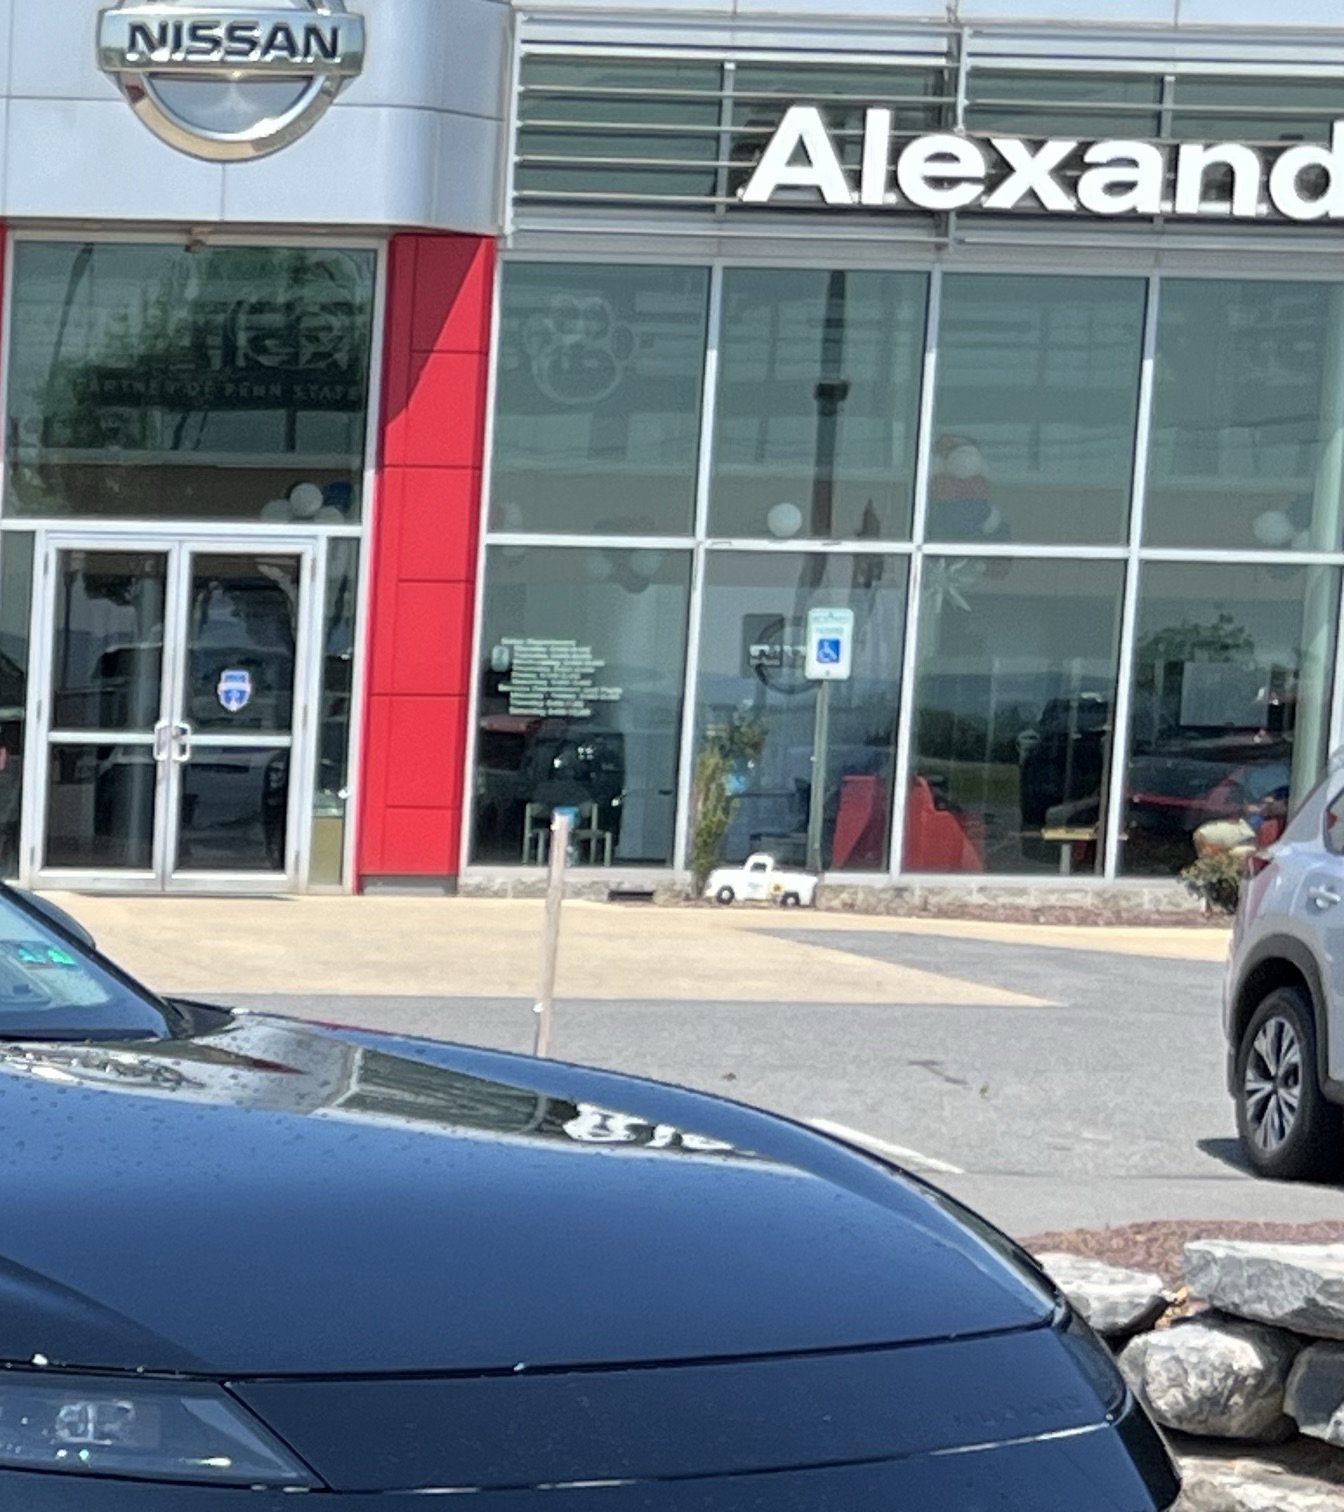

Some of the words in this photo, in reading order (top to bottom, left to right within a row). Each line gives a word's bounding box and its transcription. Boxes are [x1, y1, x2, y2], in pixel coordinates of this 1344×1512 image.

[127, 20, 342, 60] NISSAN
[737, 105, 1344, 220] Alexand
[223, 381, 283, 399] PENN
